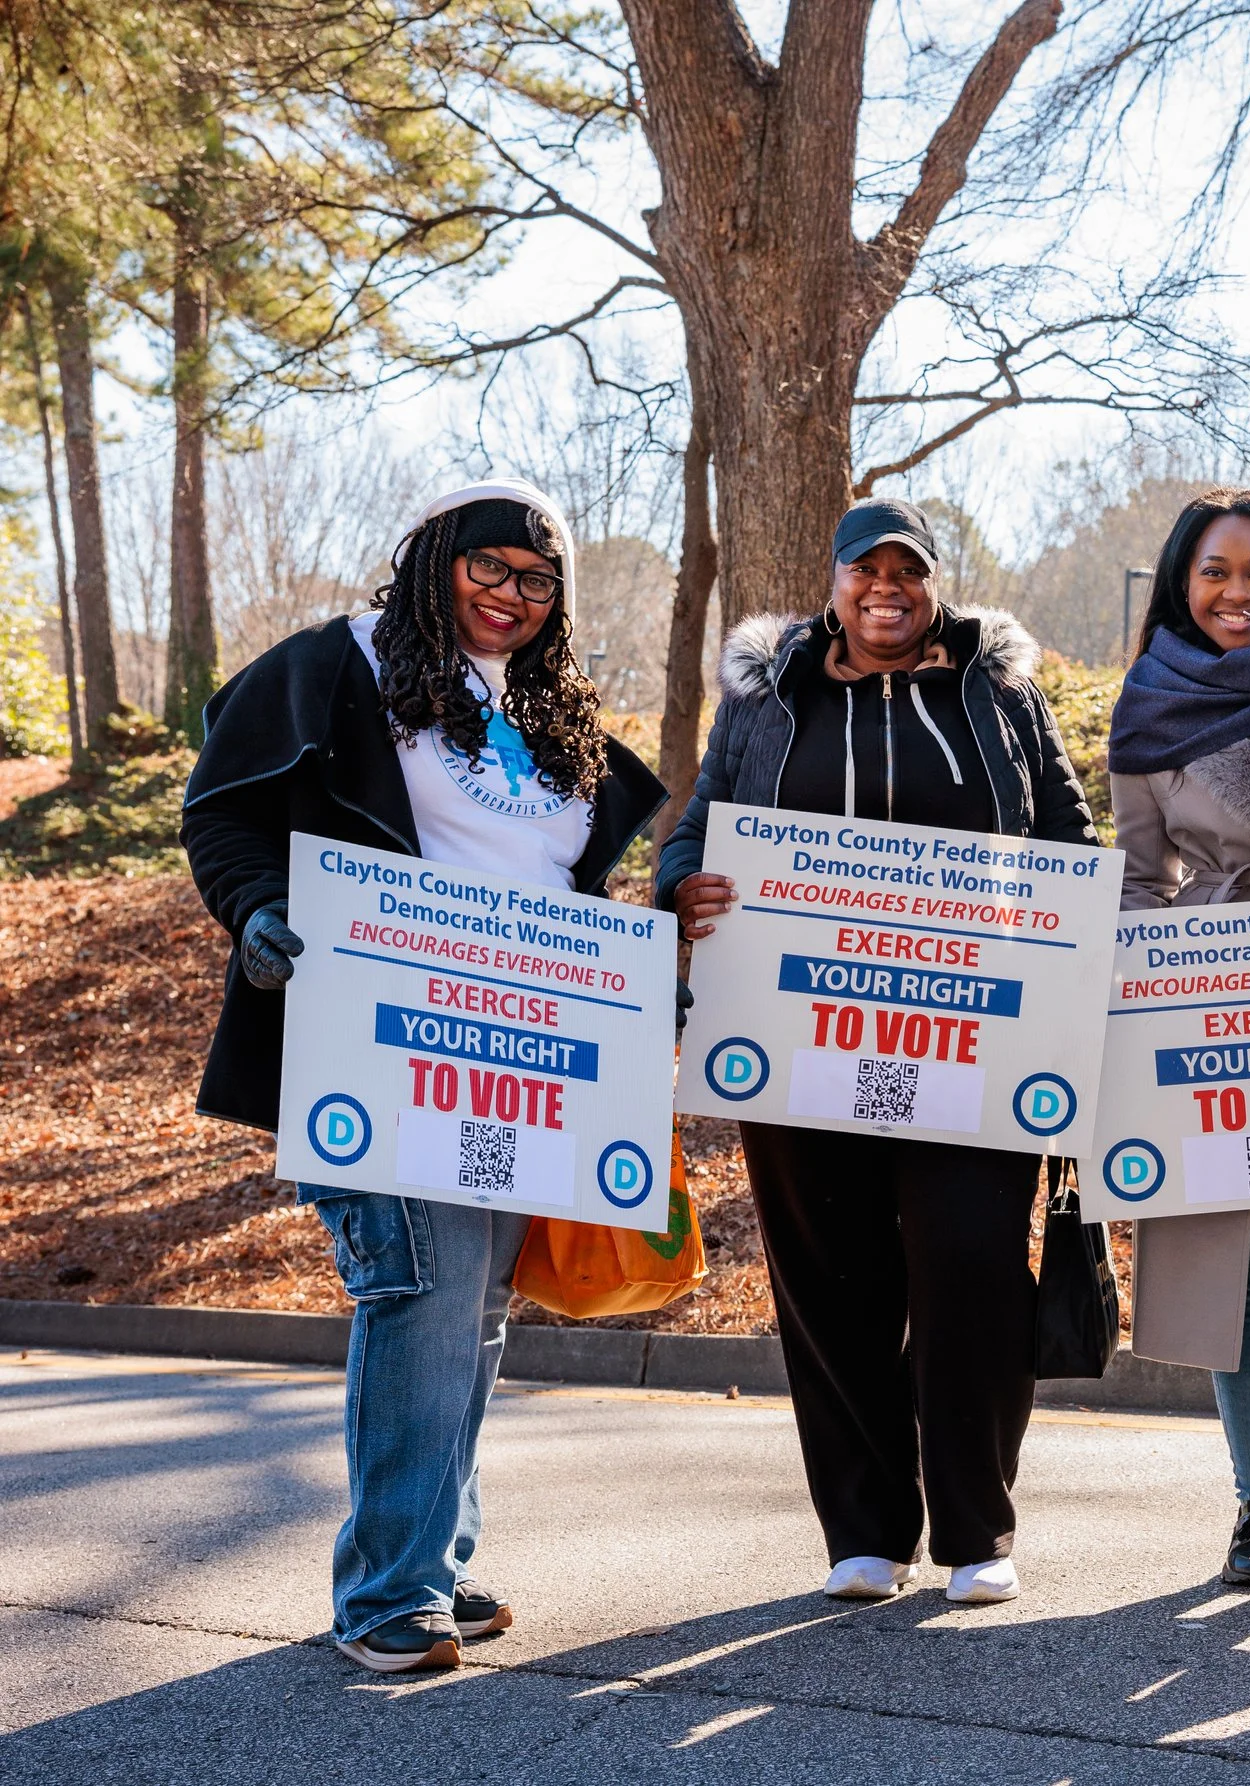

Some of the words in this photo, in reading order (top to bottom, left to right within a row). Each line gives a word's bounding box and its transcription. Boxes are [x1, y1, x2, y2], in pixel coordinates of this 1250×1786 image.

[445, 758, 459, 770] OF
[459, 775, 536, 815] DEMOCRATIC
[735, 816, 830, 846] Clayton
[837, 828, 927, 861] County
[933, 840, 1065, 873] Federation
[1072, 857, 1099, 877] of
[319, 850, 412, 888] Clayton
[419, 872, 502, 909] County
[508, 889, 625, 933] Federation
[632, 919, 654, 939] of
[793, 852, 934, 886] Democratic
[940, 870, 1033, 898] Women
[380, 892, 512, 939] Democratic
[517, 922, 600, 957] Women
[759, 879, 907, 913] ENCOURAGES
[911, 898, 1024, 928] EVERYONE
[1030, 911, 1059, 930] TO
[349, 920, 489, 965] ENCOURAGES
[494, 950, 596, 986] EVERYONE
[600, 971, 625, 992] TO
[836, 928, 980, 967] EXERCISE
[1115, 923, 1178, 948] ayton
[427, 978, 558, 1027] EXERCISE
[807, 963, 891, 997] YOUR
[900, 979, 996, 1008] RIGHT
[401, 1014, 482, 1054] YOUR
[489, 1034, 575, 1070] RIGHT
[811, 1002, 864, 1051] TO
[875, 1010, 980, 1064] VOTE
[724, 1054, 752, 1083] D
[408, 1058, 459, 1112] TO
[469, 1068, 564, 1130] VOTE
[1032, 1089, 1059, 1119] D
[1193, 1087, 1246, 1133] TO
[327, 1112, 355, 1146] D
[614, 1159, 637, 1190] D
[1122, 1156, 1149, 1185] D
